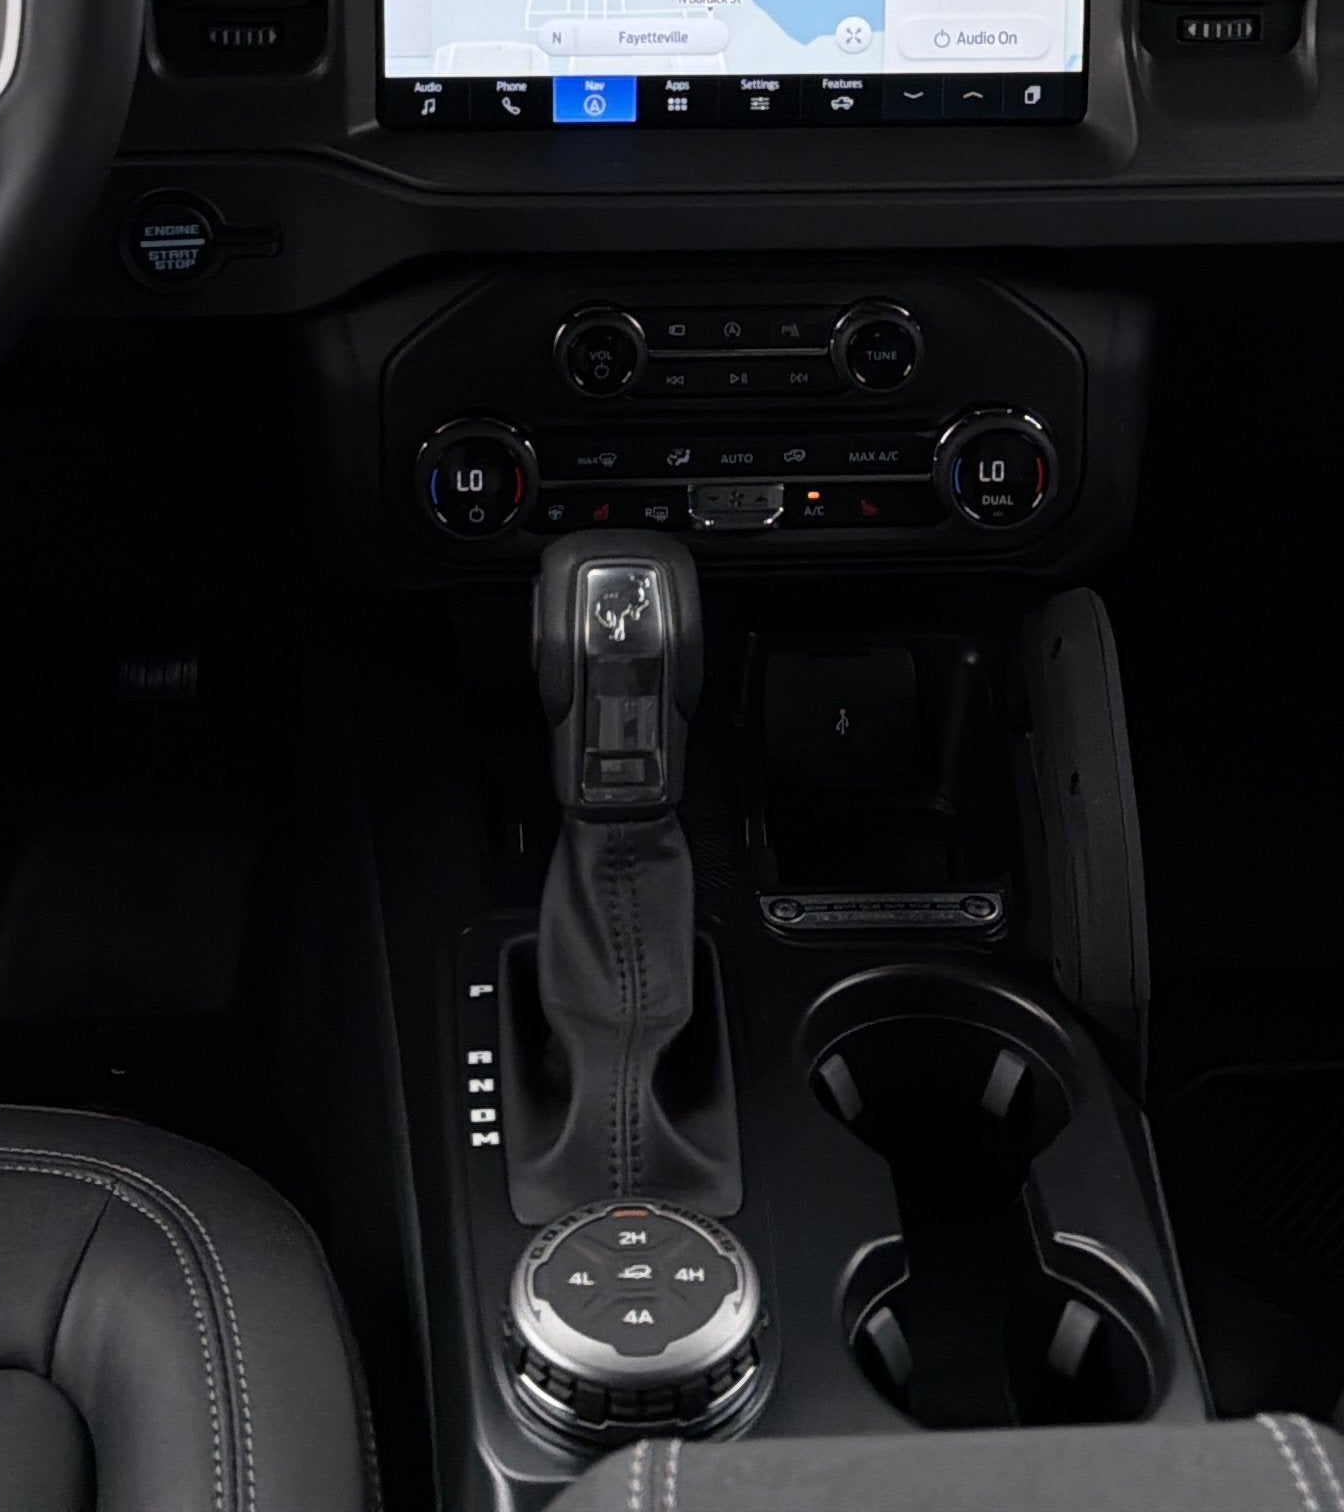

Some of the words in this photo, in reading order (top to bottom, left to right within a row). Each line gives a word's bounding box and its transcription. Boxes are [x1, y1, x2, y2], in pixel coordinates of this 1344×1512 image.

[552, 32, 561, 44] N
[618, 30, 688, 47] Fayetteville
[956, 30, 994, 46] Audio
[997, 31, 1017, 46] On
[414, 81, 442, 93] Audio
[496, 81, 527, 93] Phone
[585, 80, 605, 92] Nav
[665, 80, 690, 94] Apps
[740, 79, 780, 93] Settings
[822, 78, 863, 90] Features
[144, 224, 201, 237] ENGINE
[148, 248, 199, 261] START
[154, 258, 196, 271] STOP
[589, 350, 613, 363] VOL
[866, 349, 898, 363] TUNE
[720, 452, 754, 465] AUTO
[849, 451, 871, 464] MAX
[873, 449, 899, 464] A/C
[978, 459, 1006, 484] LO
[456, 468, 484, 493] LO
[981, 494, 1014, 507] DUAL
[803, 505, 825, 518] A/C
[469, 984, 494, 997] P
[468, 1051, 494, 1064] R
[468, 1079, 495, 1092] N
[470, 1108, 496, 1123] D
[471, 1132, 500, 1147] M
[619, 1231, 646, 1245] 2H
[568, 1272, 595, 1286] 4L
[675, 1268, 706, 1282] 4H
[622, 1310, 654, 1325] 4A
